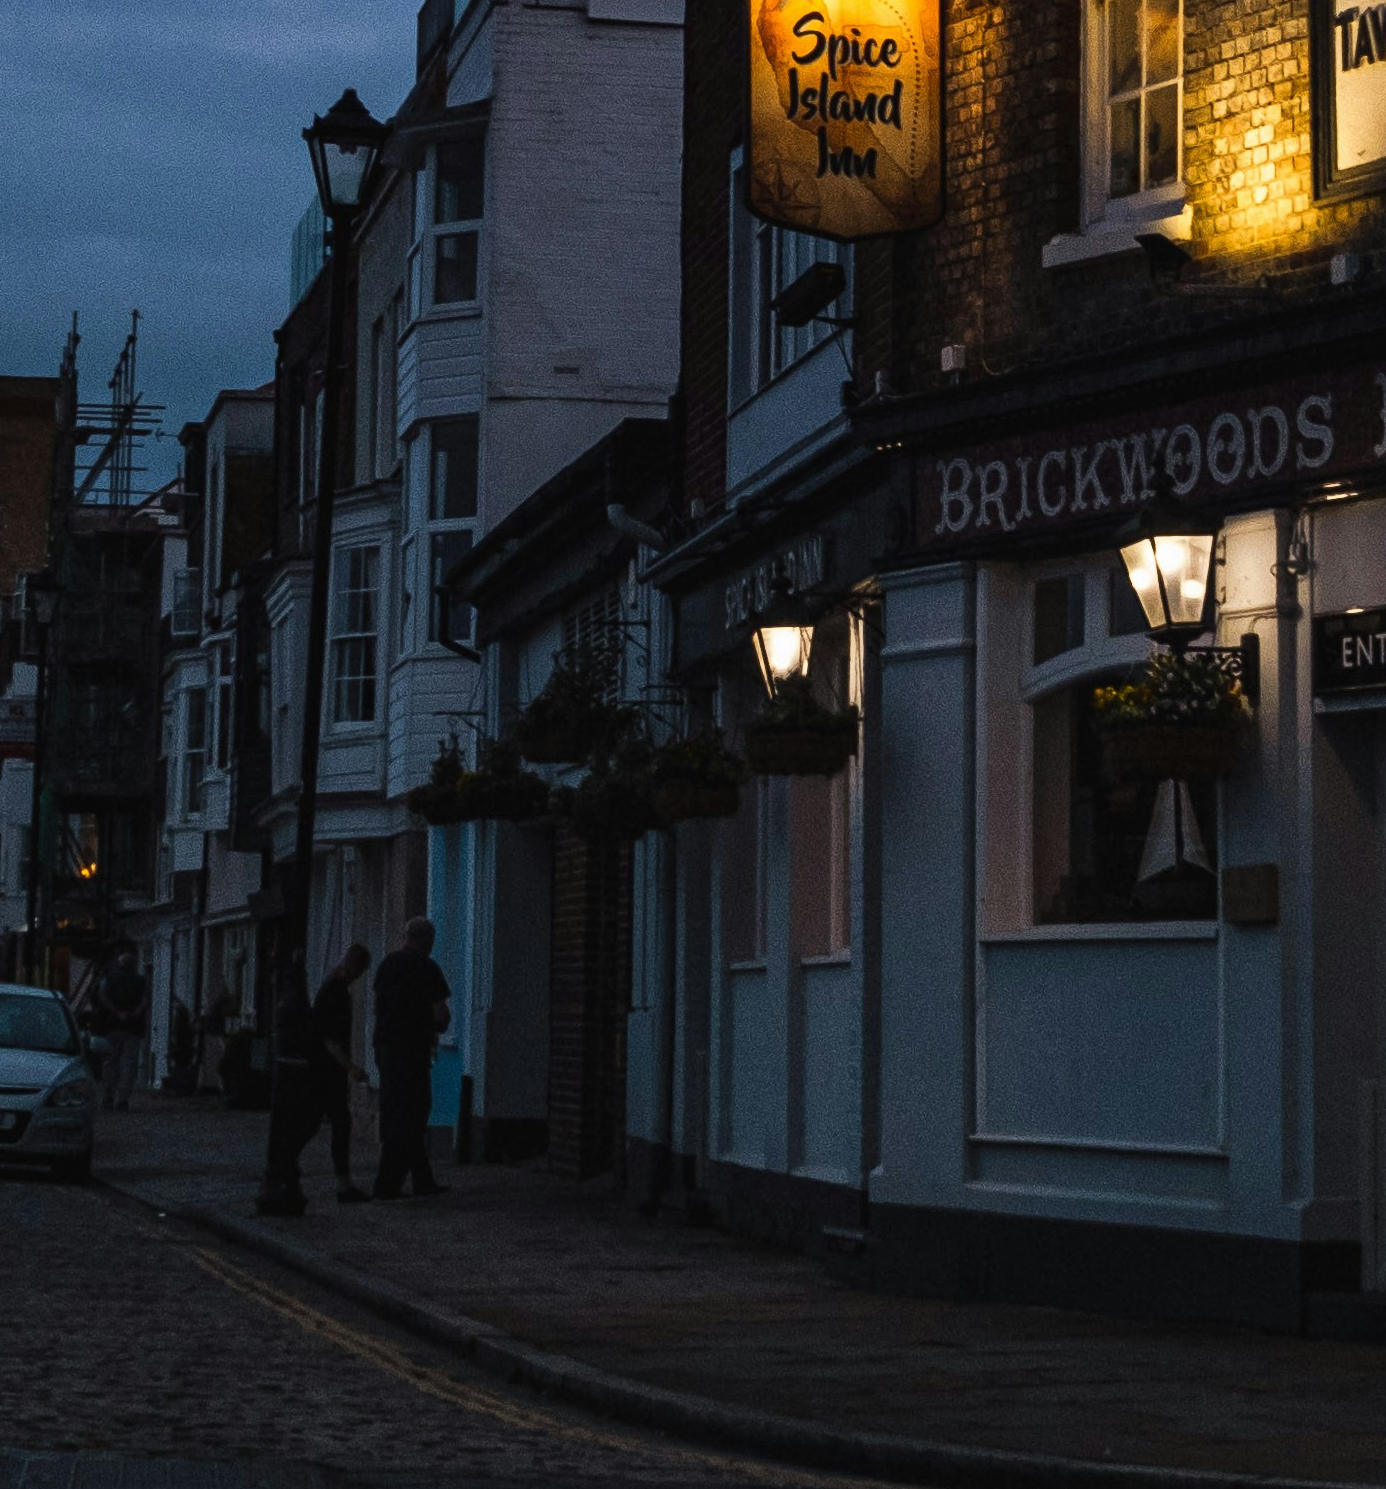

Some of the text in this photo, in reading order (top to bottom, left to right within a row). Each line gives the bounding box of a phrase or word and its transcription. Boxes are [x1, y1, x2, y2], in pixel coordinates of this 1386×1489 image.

[791, 10, 902, 82] Spice
[786, 67, 903, 130] Island
[815, 124, 878, 179] Inn
[933, 391, 1336, 537] BRICKWOODS
